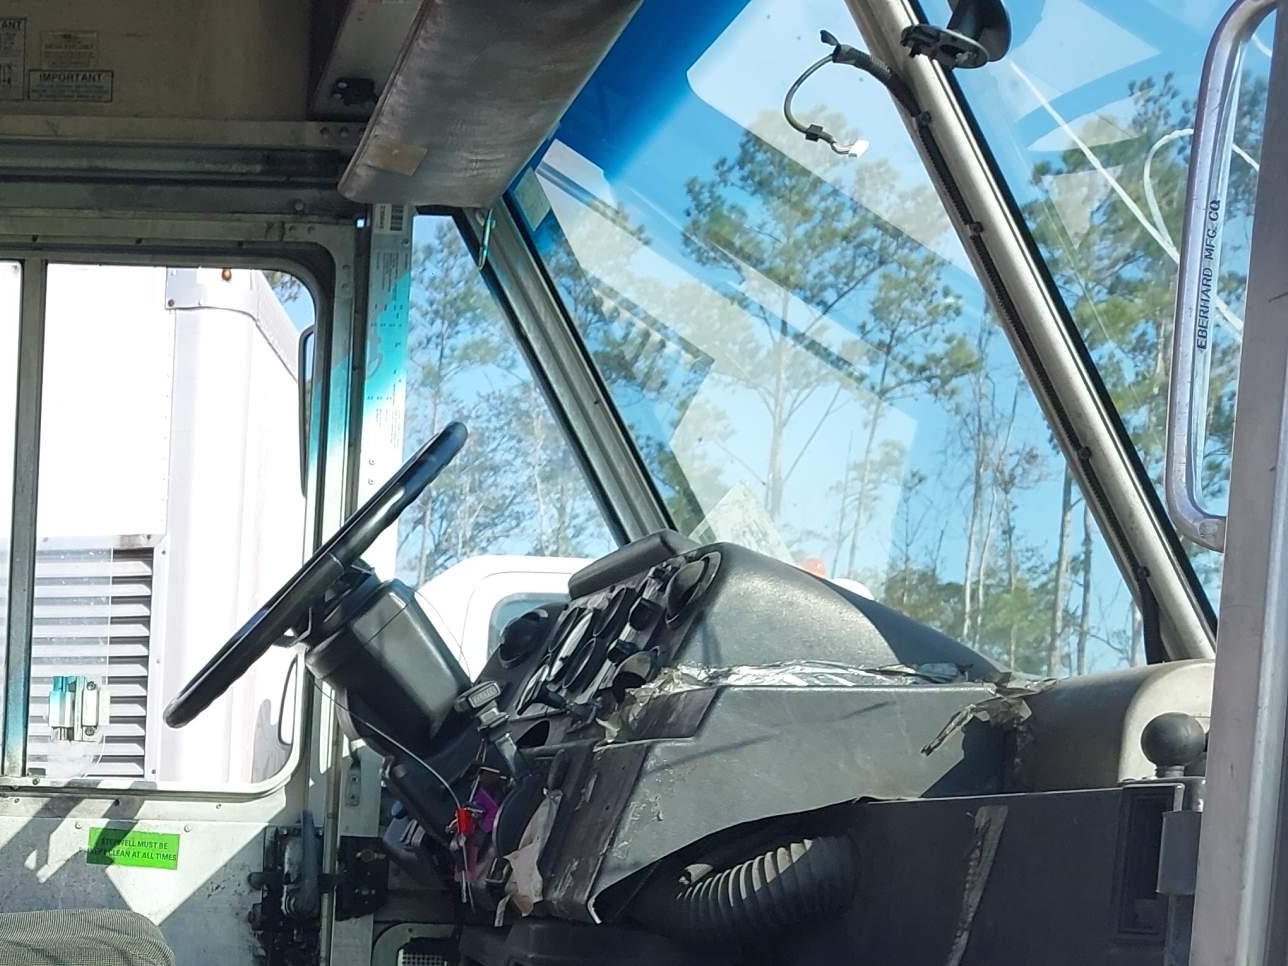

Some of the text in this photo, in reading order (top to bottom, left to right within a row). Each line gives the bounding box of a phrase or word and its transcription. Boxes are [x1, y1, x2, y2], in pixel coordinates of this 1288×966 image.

[40, 73, 102, 82] IMPORTANT
[1196, 266, 1213, 349] EBERHARD
[142, 852, 153, 860] ALL
[156, 853, 176, 861] TIMES
